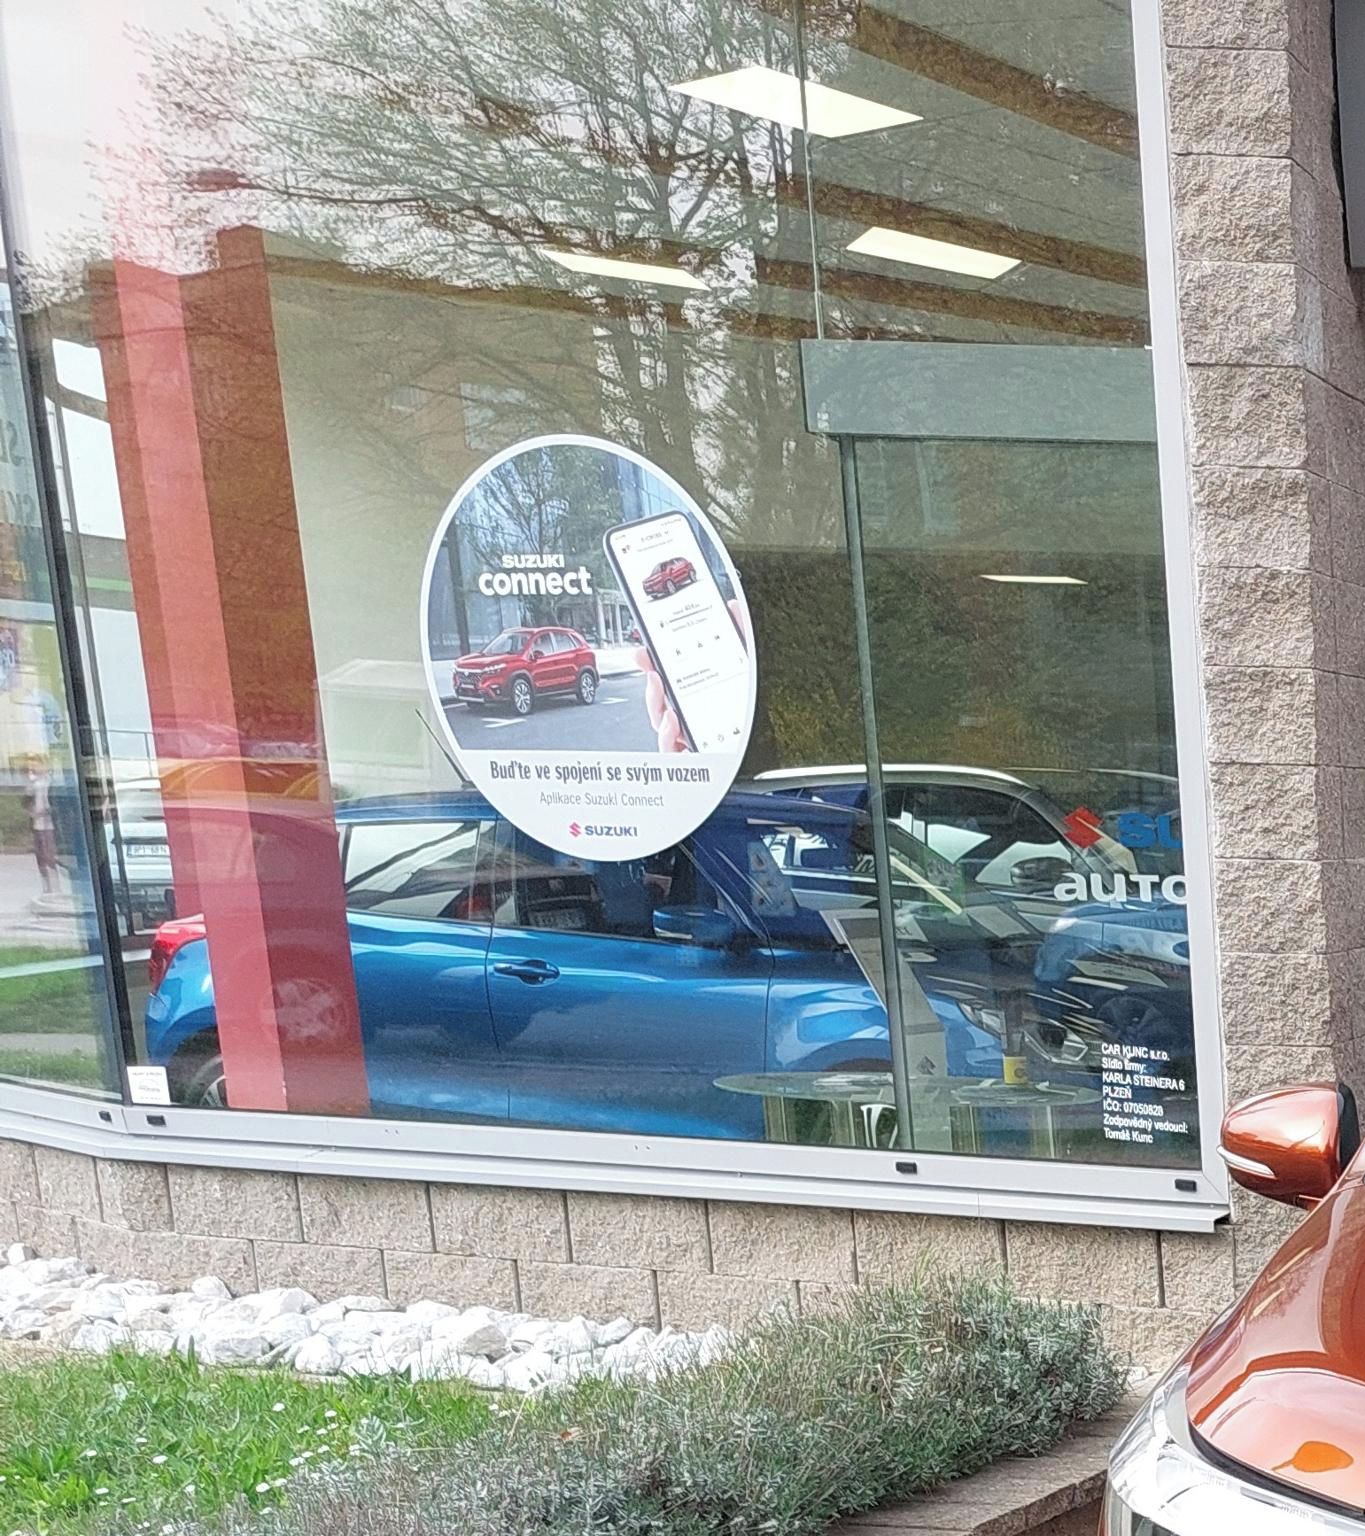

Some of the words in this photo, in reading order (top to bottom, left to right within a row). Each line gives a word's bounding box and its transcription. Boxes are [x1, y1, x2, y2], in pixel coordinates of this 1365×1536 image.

[502, 554, 565, 569] SUZUKI
[479, 566, 593, 596] connect
[536, 764, 551, 780] ve
[555, 762, 602, 784] spojení
[607, 766, 622, 781] se
[627, 763, 662, 785] svým
[667, 767, 710, 782] vozem
[540, 792, 581, 806] Aplikace
[621, 793, 664, 807] Connect
[585, 825, 638, 837] SUZUKI
[1101, 1042, 1120, 1056] CAR
[1122, 1045, 1149, 1058] KUNC
[1102, 1071, 1132, 1085] KARLA
[1133, 1074, 1178, 1091] STEINERA
[1178, 1079, 1186, 1092] 6
[1102, 1085, 1132, 1099] PLZEŇ
[1103, 1098, 1122, 1112] IČO:
[1103, 1113, 1153, 1131] Zodpovědný
[1104, 1128, 1131, 1141] Tomáš
[1131, 1130, 1154, 1143] Kunc
